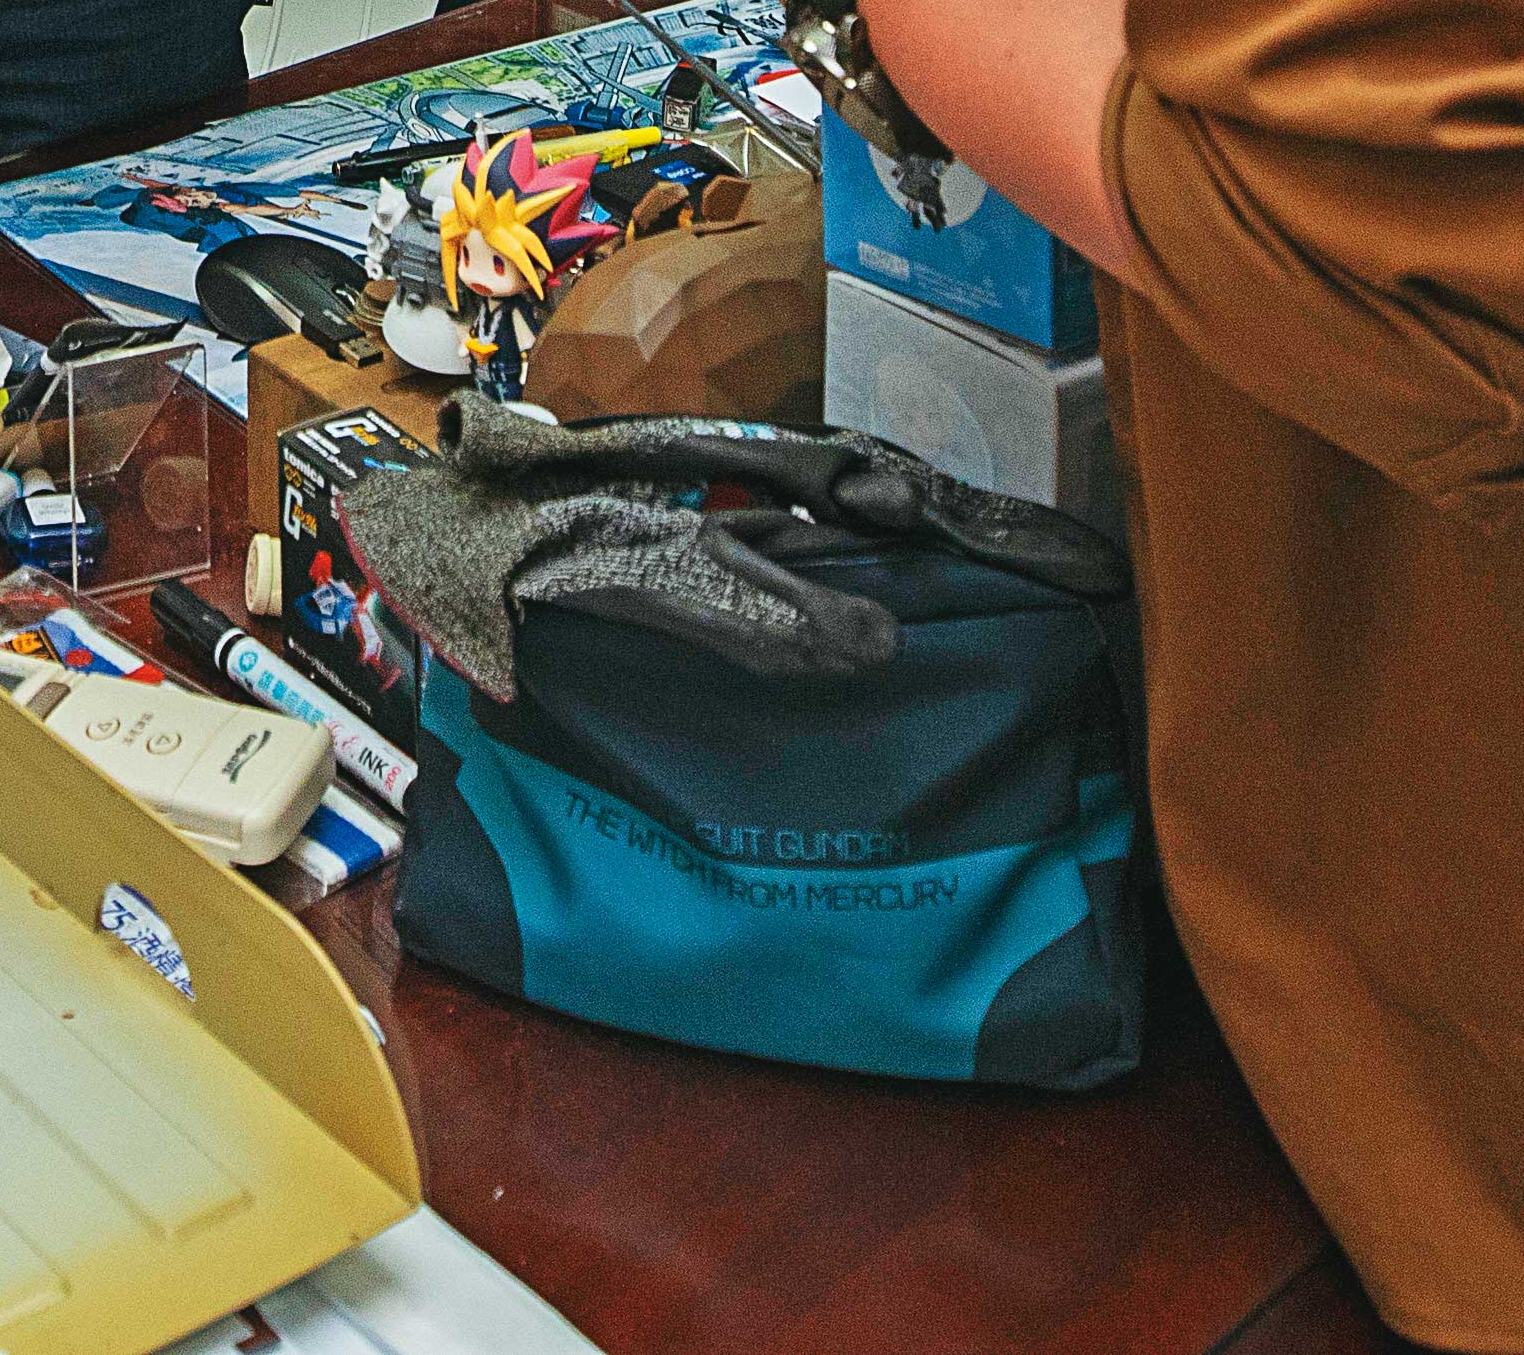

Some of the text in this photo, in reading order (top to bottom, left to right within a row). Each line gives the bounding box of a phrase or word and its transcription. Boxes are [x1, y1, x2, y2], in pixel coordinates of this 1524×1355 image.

[283, 446, 325, 490] tomica
[359, 747, 390, 780] INK
[565, 791, 960, 912] THE WITCH FROM MERCURY
